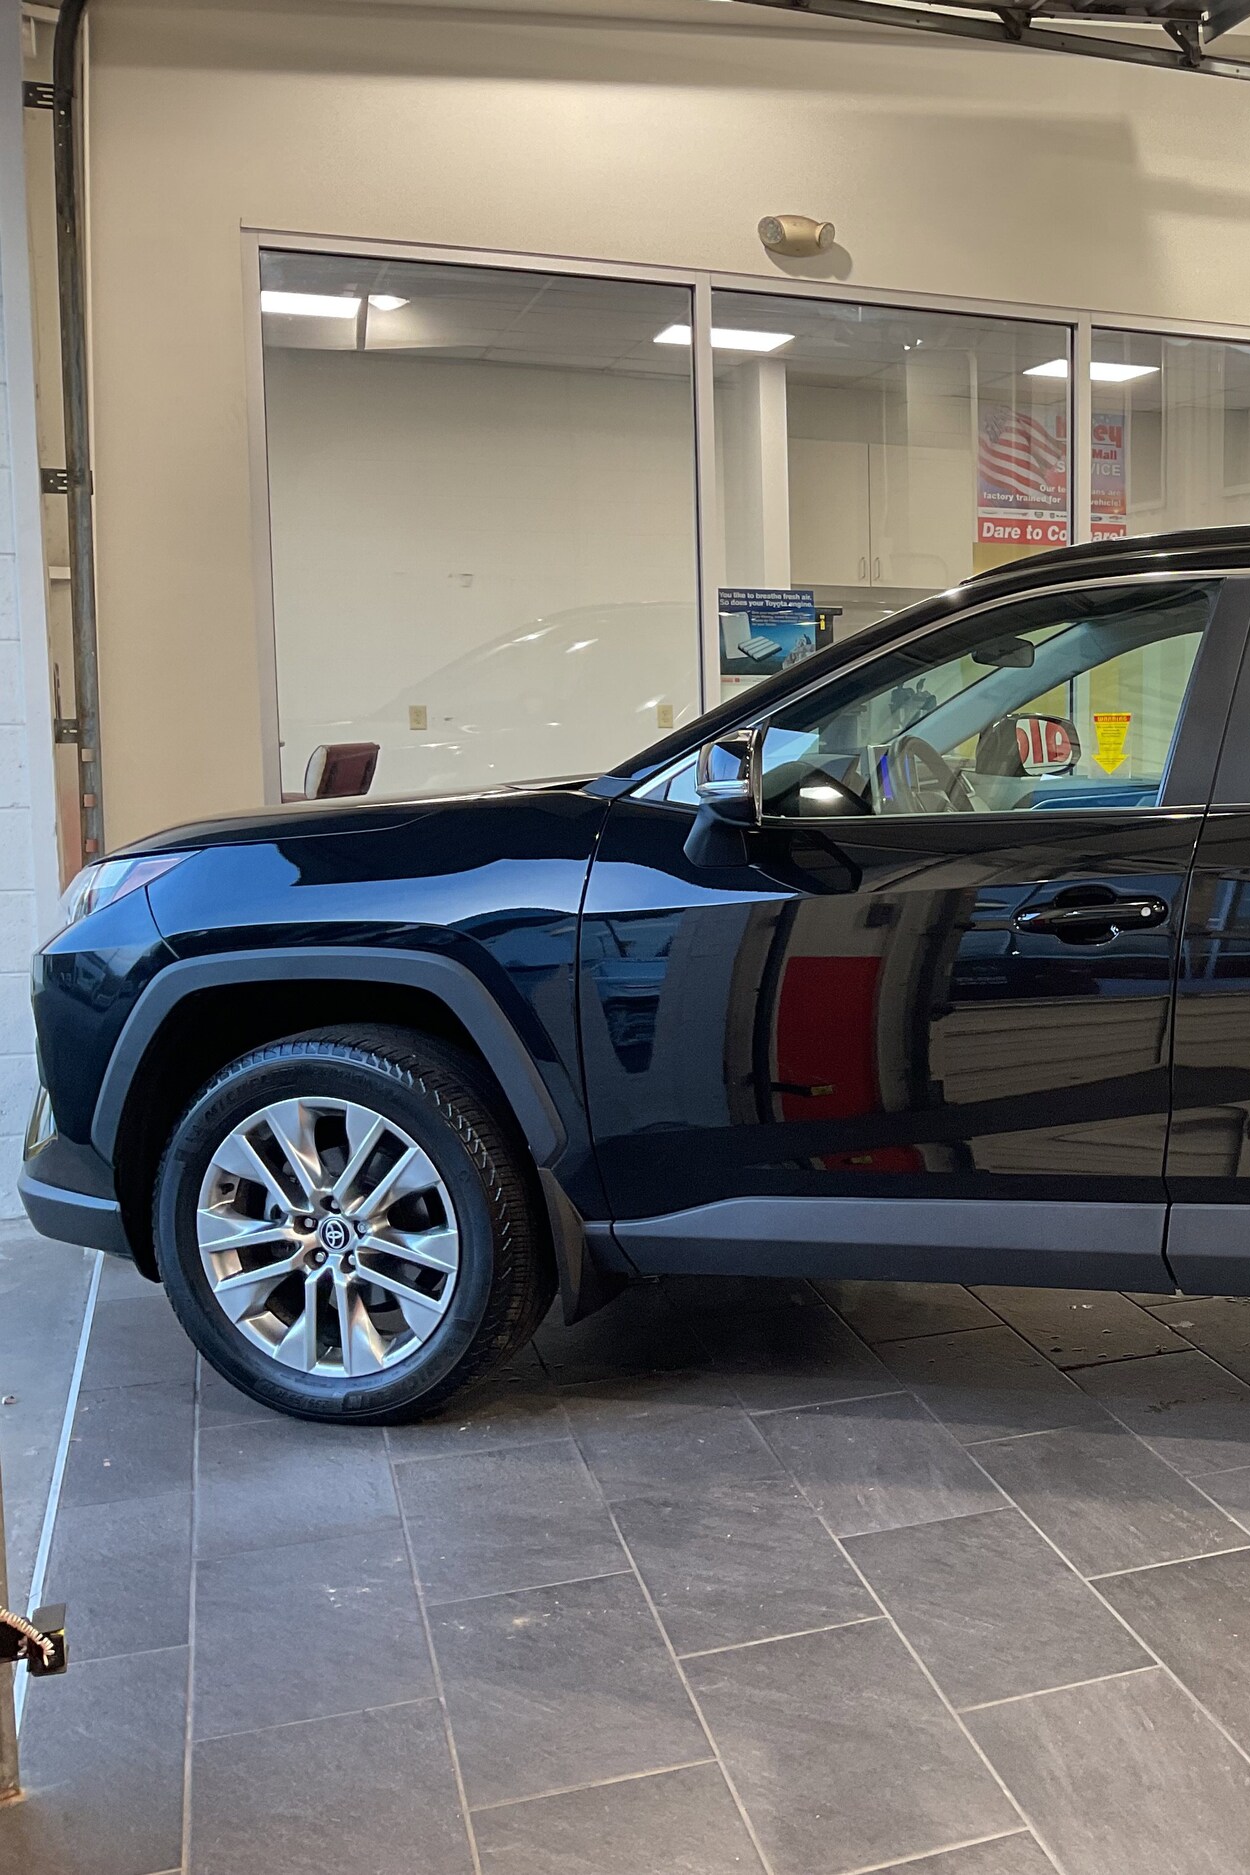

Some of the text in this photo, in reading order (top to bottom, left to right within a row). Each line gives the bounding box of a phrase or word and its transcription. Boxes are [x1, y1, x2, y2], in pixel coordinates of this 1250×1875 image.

[1040, 484, 1055, 493] Our
[983, 491, 1014, 502] factory
[1016, 494, 1048, 503] trained
[1049, 495, 1062, 505] for
[982, 522, 1021, 539] Dare
[1026, 524, 1043, 540] to
[719, 591, 732, 599] You
[733, 591, 746, 599] like
[756, 592, 782, 600] breathe
[783, 593, 801, 601] fresh
[719, 598, 729, 606] So
[730, 598, 747, 606] does
[748, 600, 764, 608] your
[765, 599, 787, 608] Toyota
